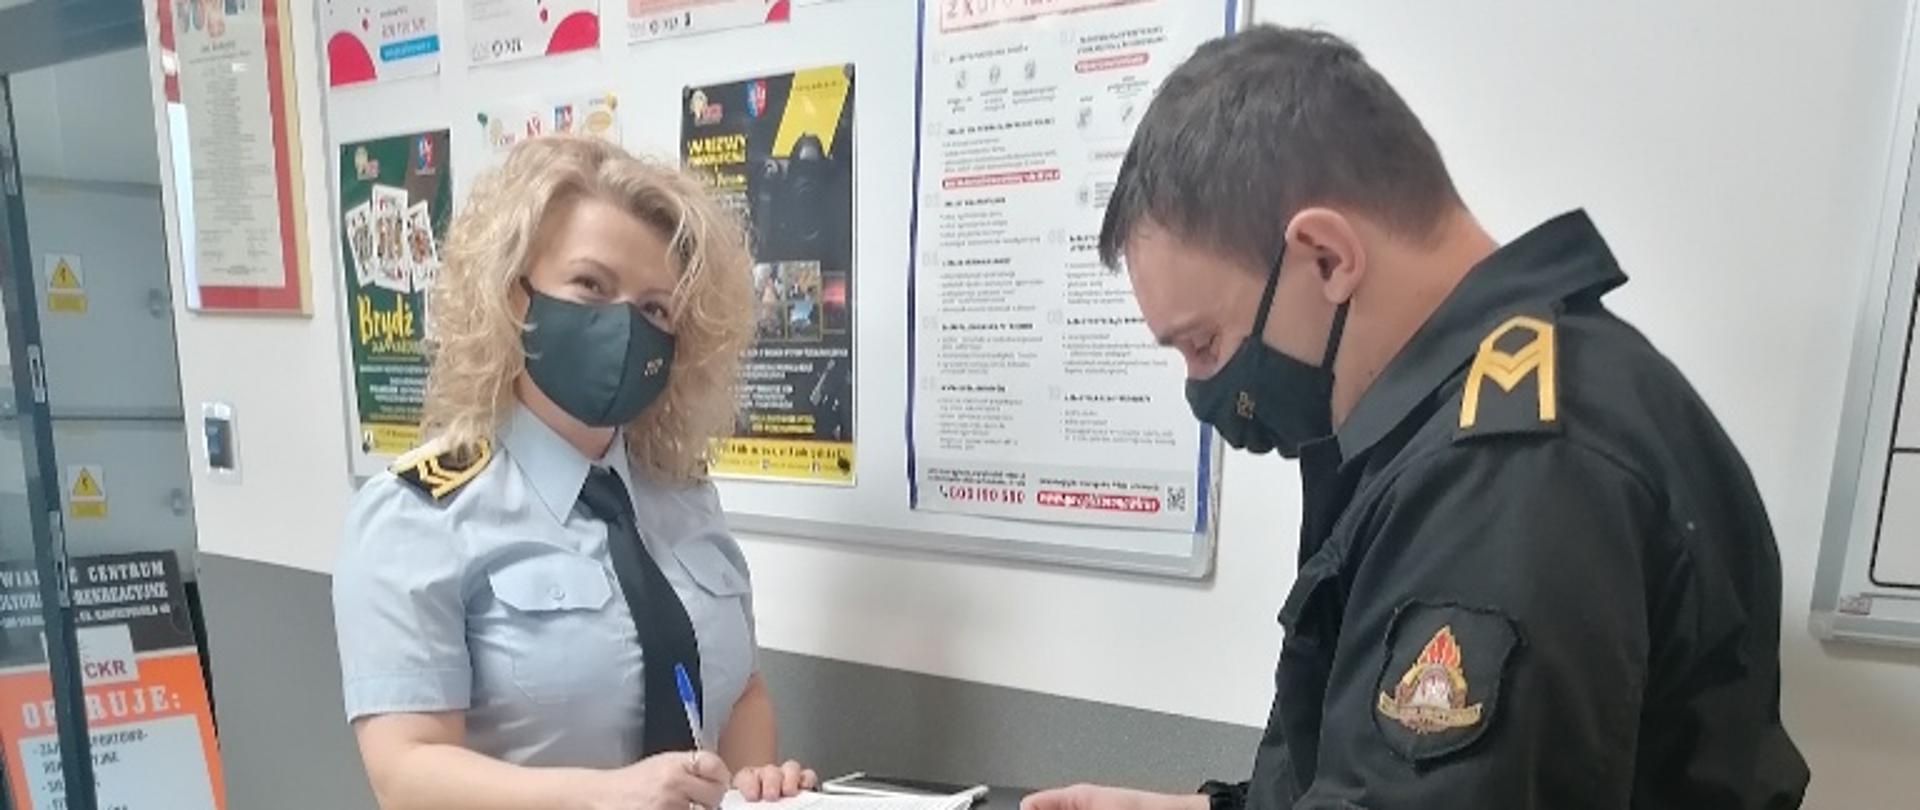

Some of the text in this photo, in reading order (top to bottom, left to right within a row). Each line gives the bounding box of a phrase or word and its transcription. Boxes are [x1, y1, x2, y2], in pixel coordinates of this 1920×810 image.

[356, 293, 415, 346] Brydż
[89, 560, 165, 582] CENTRUM
[22, 685, 182, 729] OFRUJE:
